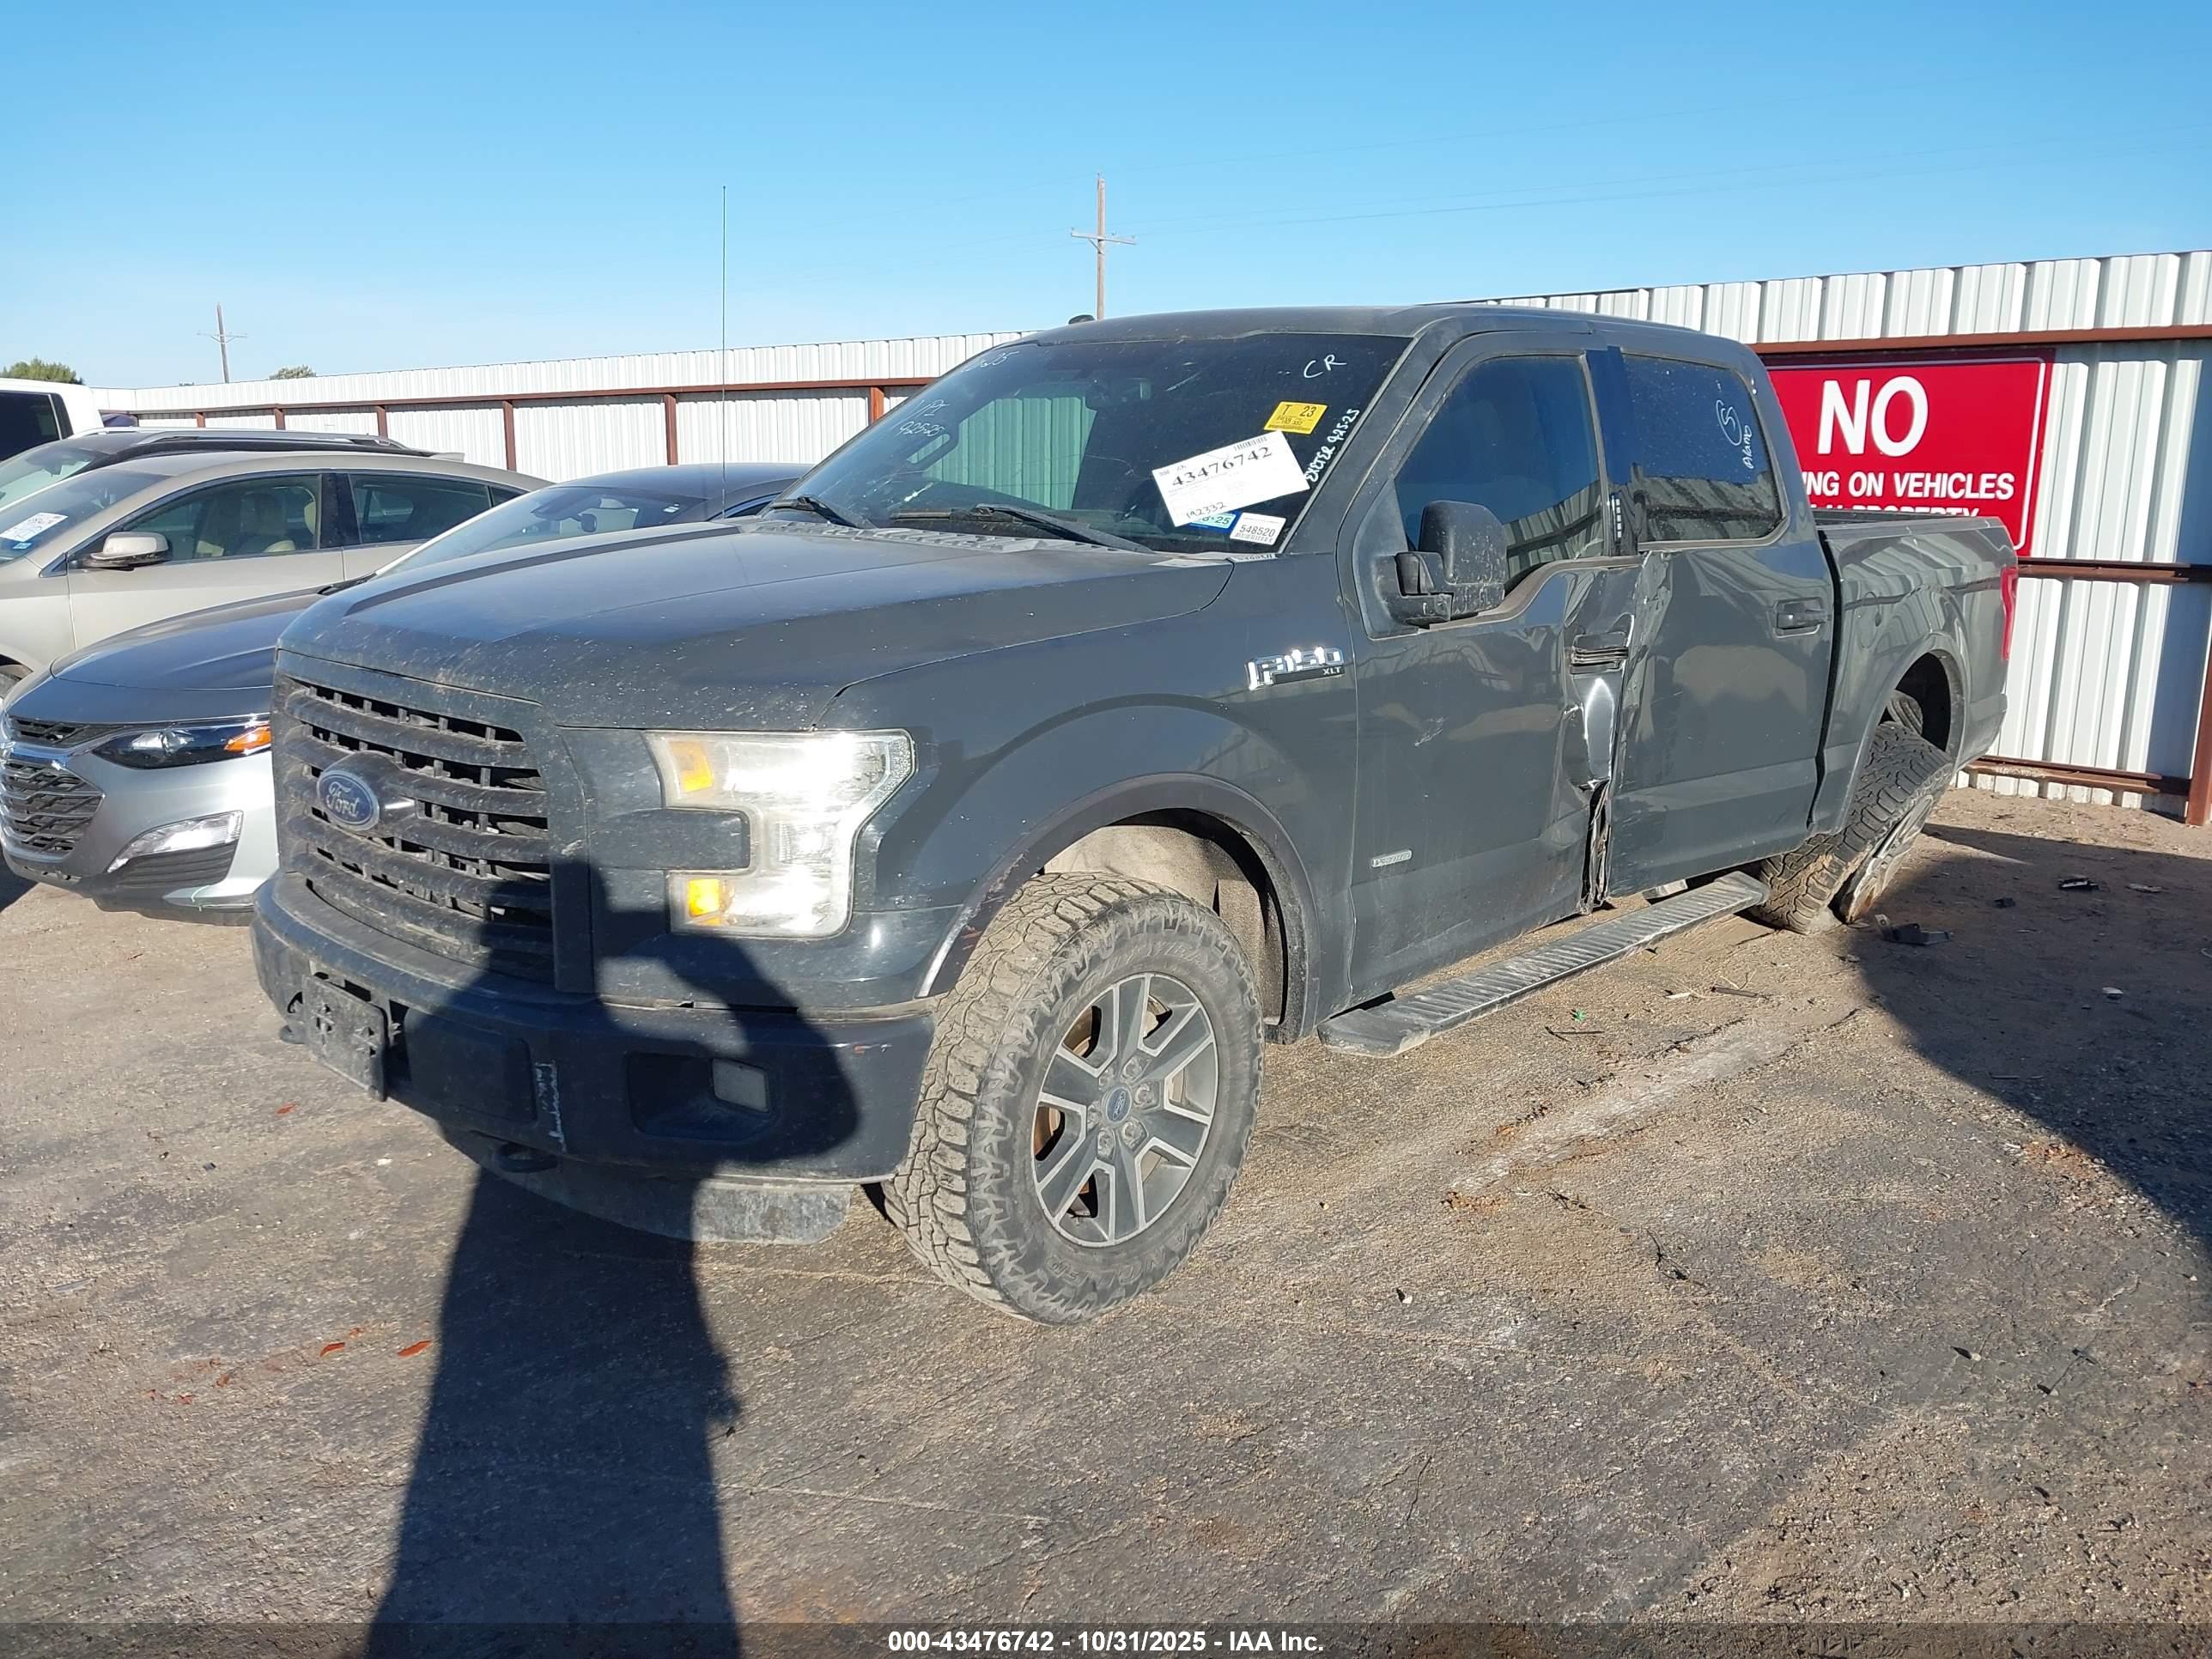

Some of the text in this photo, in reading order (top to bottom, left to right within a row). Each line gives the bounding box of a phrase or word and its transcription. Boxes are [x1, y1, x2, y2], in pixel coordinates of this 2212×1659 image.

[1304, 354, 1347, 378] CR
[1299, 405, 1316, 417] 23
[1818, 375, 1929, 457] NO
[1172, 446, 1273, 486] 43476742
[1849, 471, 1884, 497] ON
[1893, 472, 2014, 500] VEHICLES
[1215, 516, 1231, 525] 25
[1239, 525, 1276, 537] 548520
[1322, 666, 1341, 676] XLT
[326, 781, 360, 817] Ford
